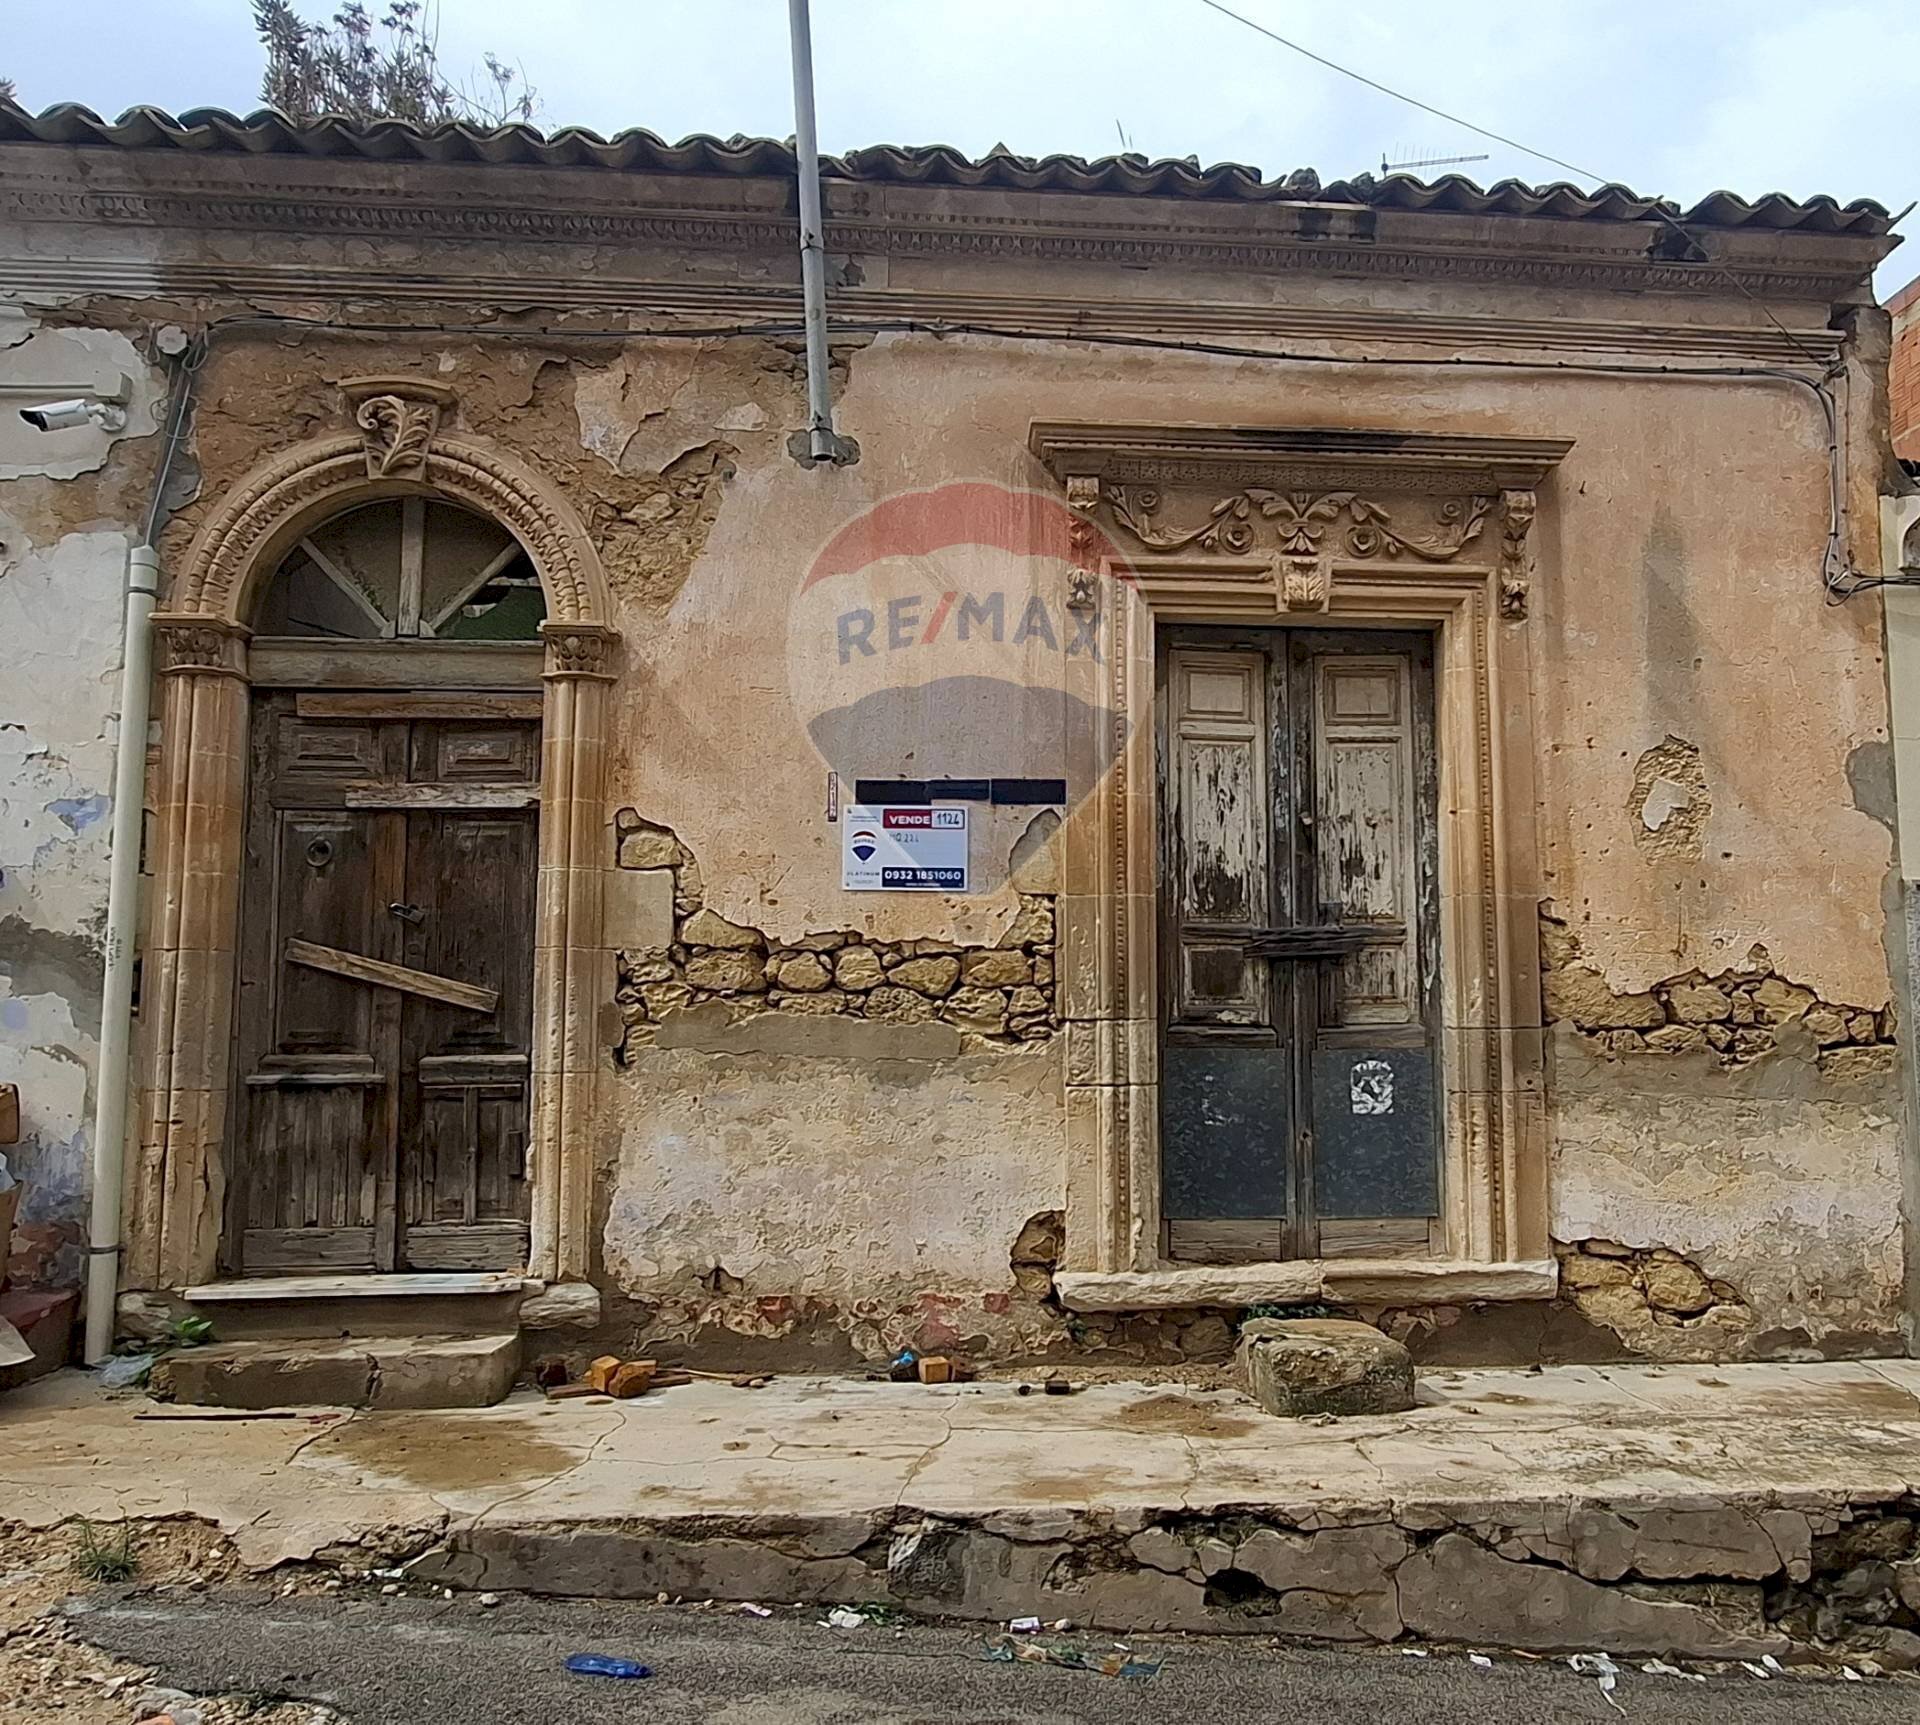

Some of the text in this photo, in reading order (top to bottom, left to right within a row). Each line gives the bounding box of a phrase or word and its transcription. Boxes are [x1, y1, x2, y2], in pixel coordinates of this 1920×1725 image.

[888, 815, 931, 825] VENDE
[884, 870, 962, 880] 0932 1851060
